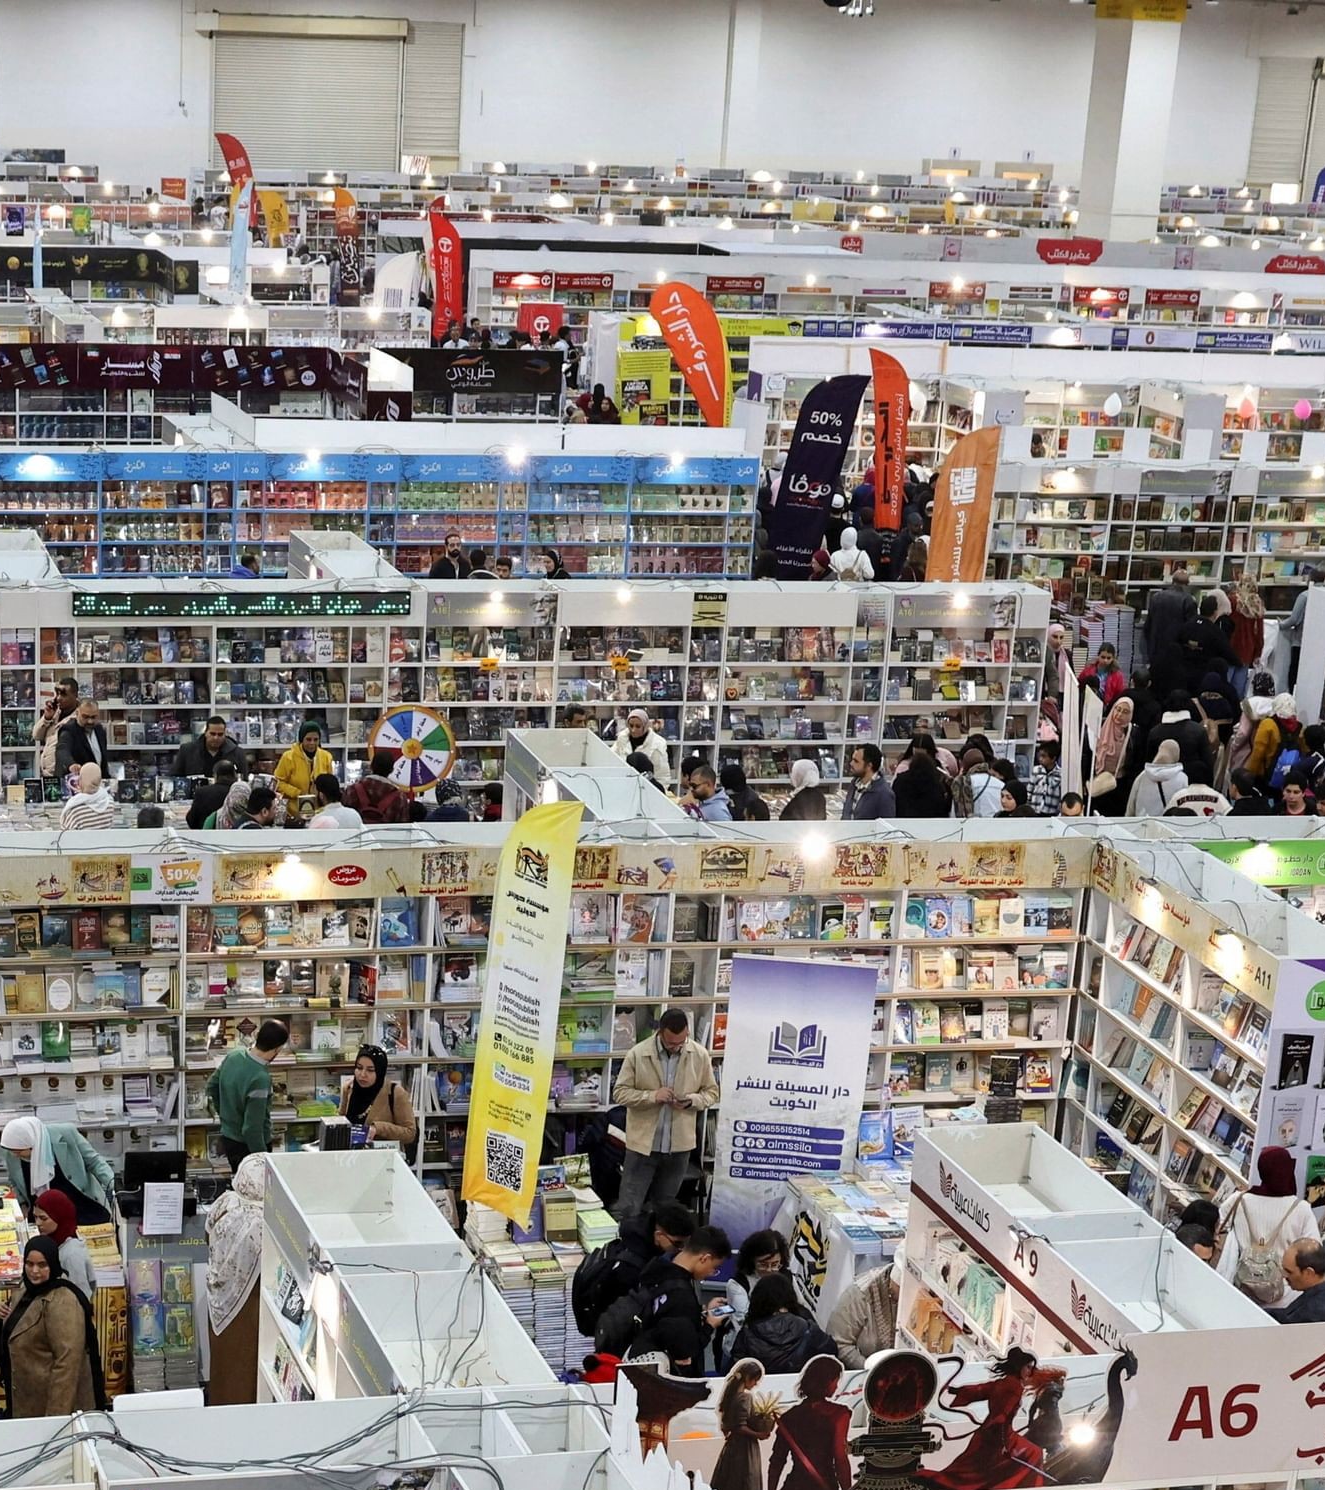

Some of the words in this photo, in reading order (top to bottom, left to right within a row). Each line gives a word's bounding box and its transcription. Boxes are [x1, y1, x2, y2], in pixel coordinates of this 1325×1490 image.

[936, 326, 951, 338] B29
[809, 410, 843, 427] 50%
[800, 431, 842, 444] خصم
[166, 868, 198, 880] 50%
[1255, 967, 1272, 990] A11
[736, 1075, 771, 1091] للنشر
[776, 1079, 828, 1096] المسيلة
[832, 1086, 850, 1099] دار
[769, 1097, 817, 1110] الكويت
[767, 1139, 812, 1152] almssila
[746, 1154, 821, 1168] www.almssila.com
[1168, 1384, 1261, 1442] A6
